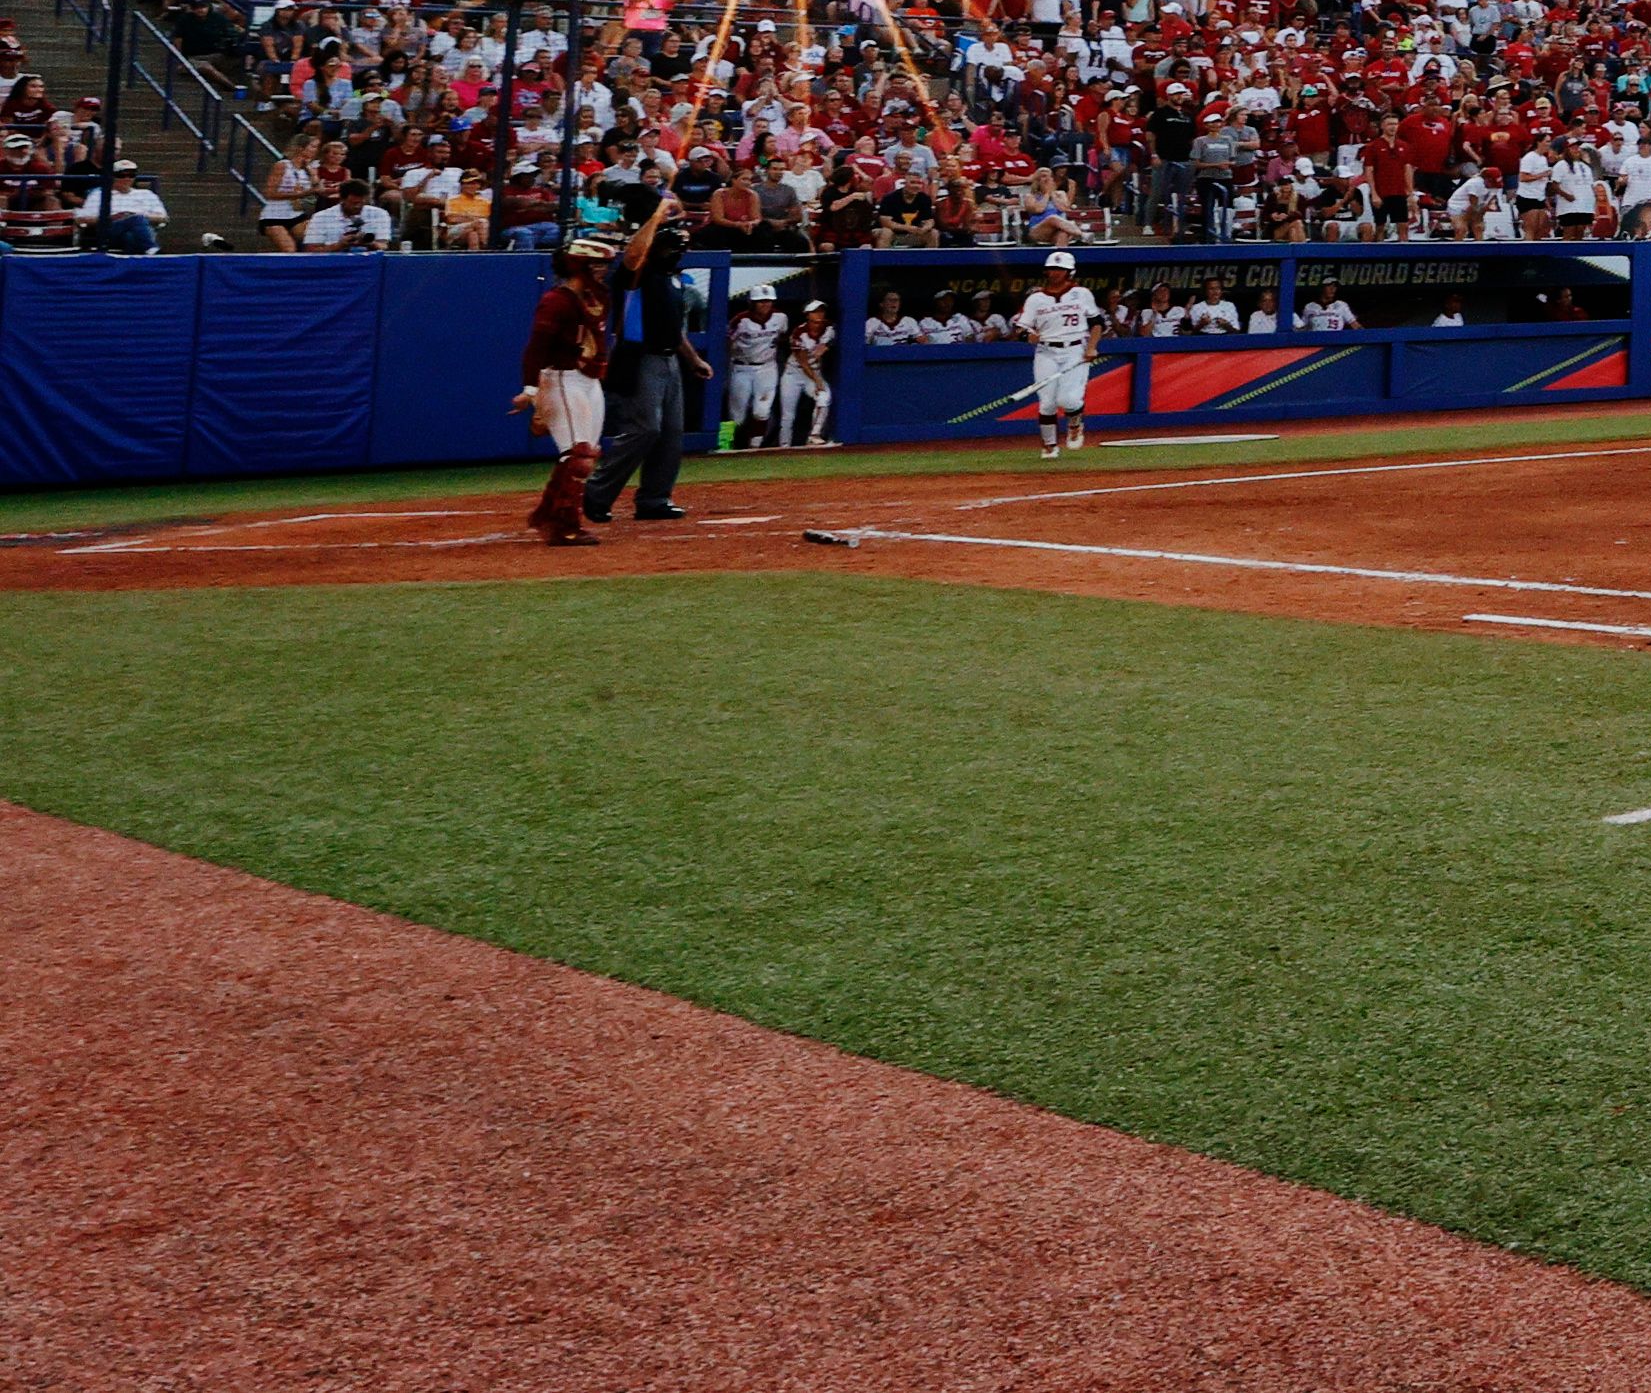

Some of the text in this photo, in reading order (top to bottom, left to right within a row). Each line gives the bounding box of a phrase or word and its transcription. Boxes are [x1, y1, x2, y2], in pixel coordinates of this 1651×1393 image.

[1340, 263, 1409, 287] WORLD
[1411, 261, 1480, 284] SERIES
[1062, 313, 1079, 326] 78
